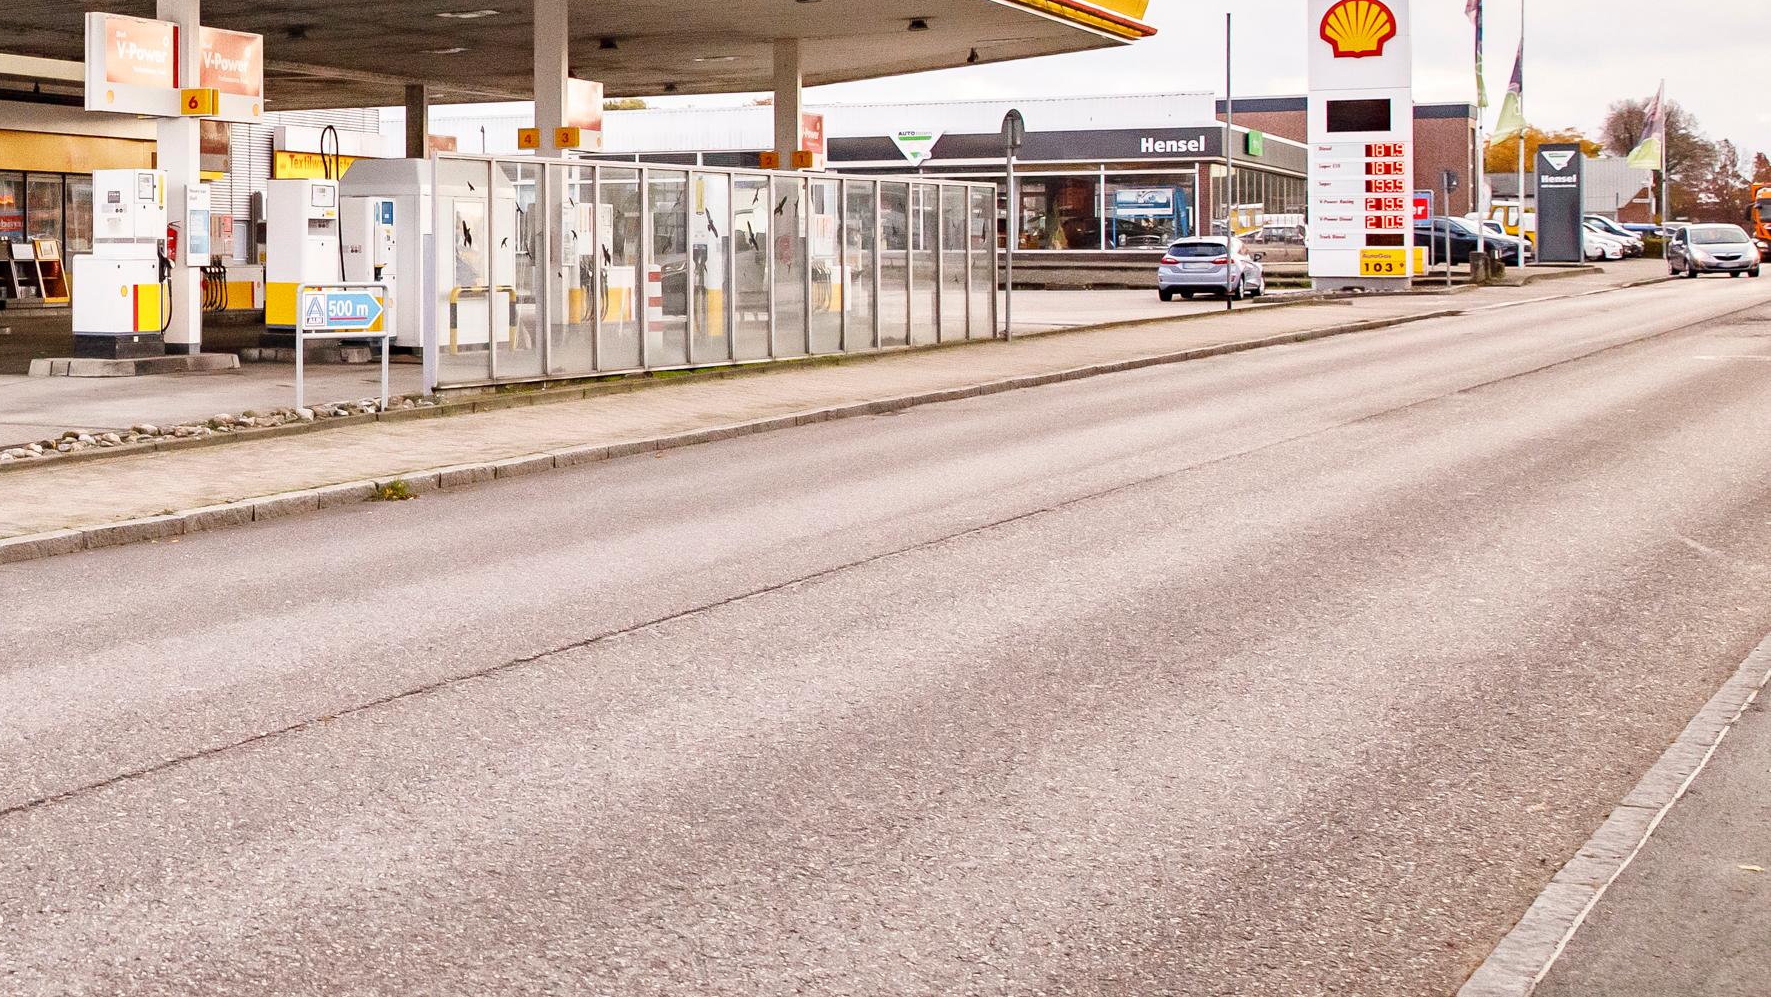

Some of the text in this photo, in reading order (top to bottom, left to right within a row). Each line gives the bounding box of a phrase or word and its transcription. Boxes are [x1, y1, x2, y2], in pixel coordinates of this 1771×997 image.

[116, 40, 168, 63] V-Power
[203, 52, 249, 73] V-Power
[188, 96, 199, 109] 6
[524, 134, 532, 144] 4
[561, 132, 569, 143] 3
[1140, 135, 1205, 153] Hensel
[1371, 144, 1404, 157] 187.9
[1371, 162, 1404, 175] 187.9
[1541, 174, 1577, 183] Hensel
[1371, 179, 1404, 193] 193.9
[1366, 198, 1404, 211] 219.9
[1366, 215, 1404, 229] 210.9
[328, 300, 369, 316] 500 m
